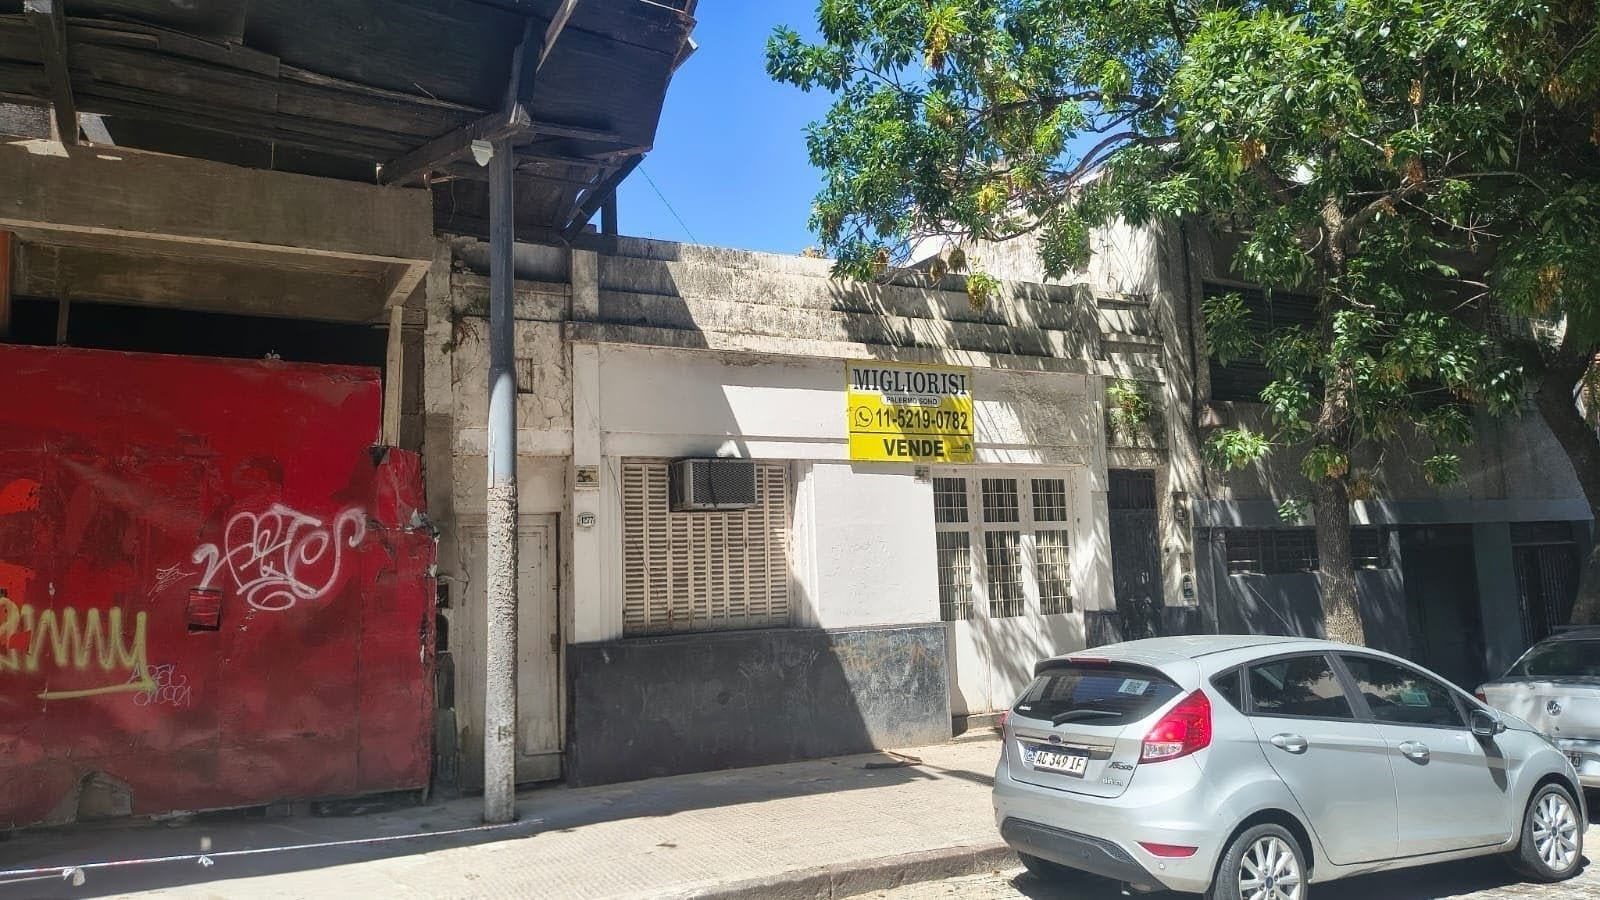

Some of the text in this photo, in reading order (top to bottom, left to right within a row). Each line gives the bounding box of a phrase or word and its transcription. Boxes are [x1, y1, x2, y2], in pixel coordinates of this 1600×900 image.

[852, 368, 967, 396] MIGLIORISI
[886, 396, 918, 405] PALERMO
[875, 407, 968, 430] 11-5219-0782
[883, 438, 945, 457] VENDE
